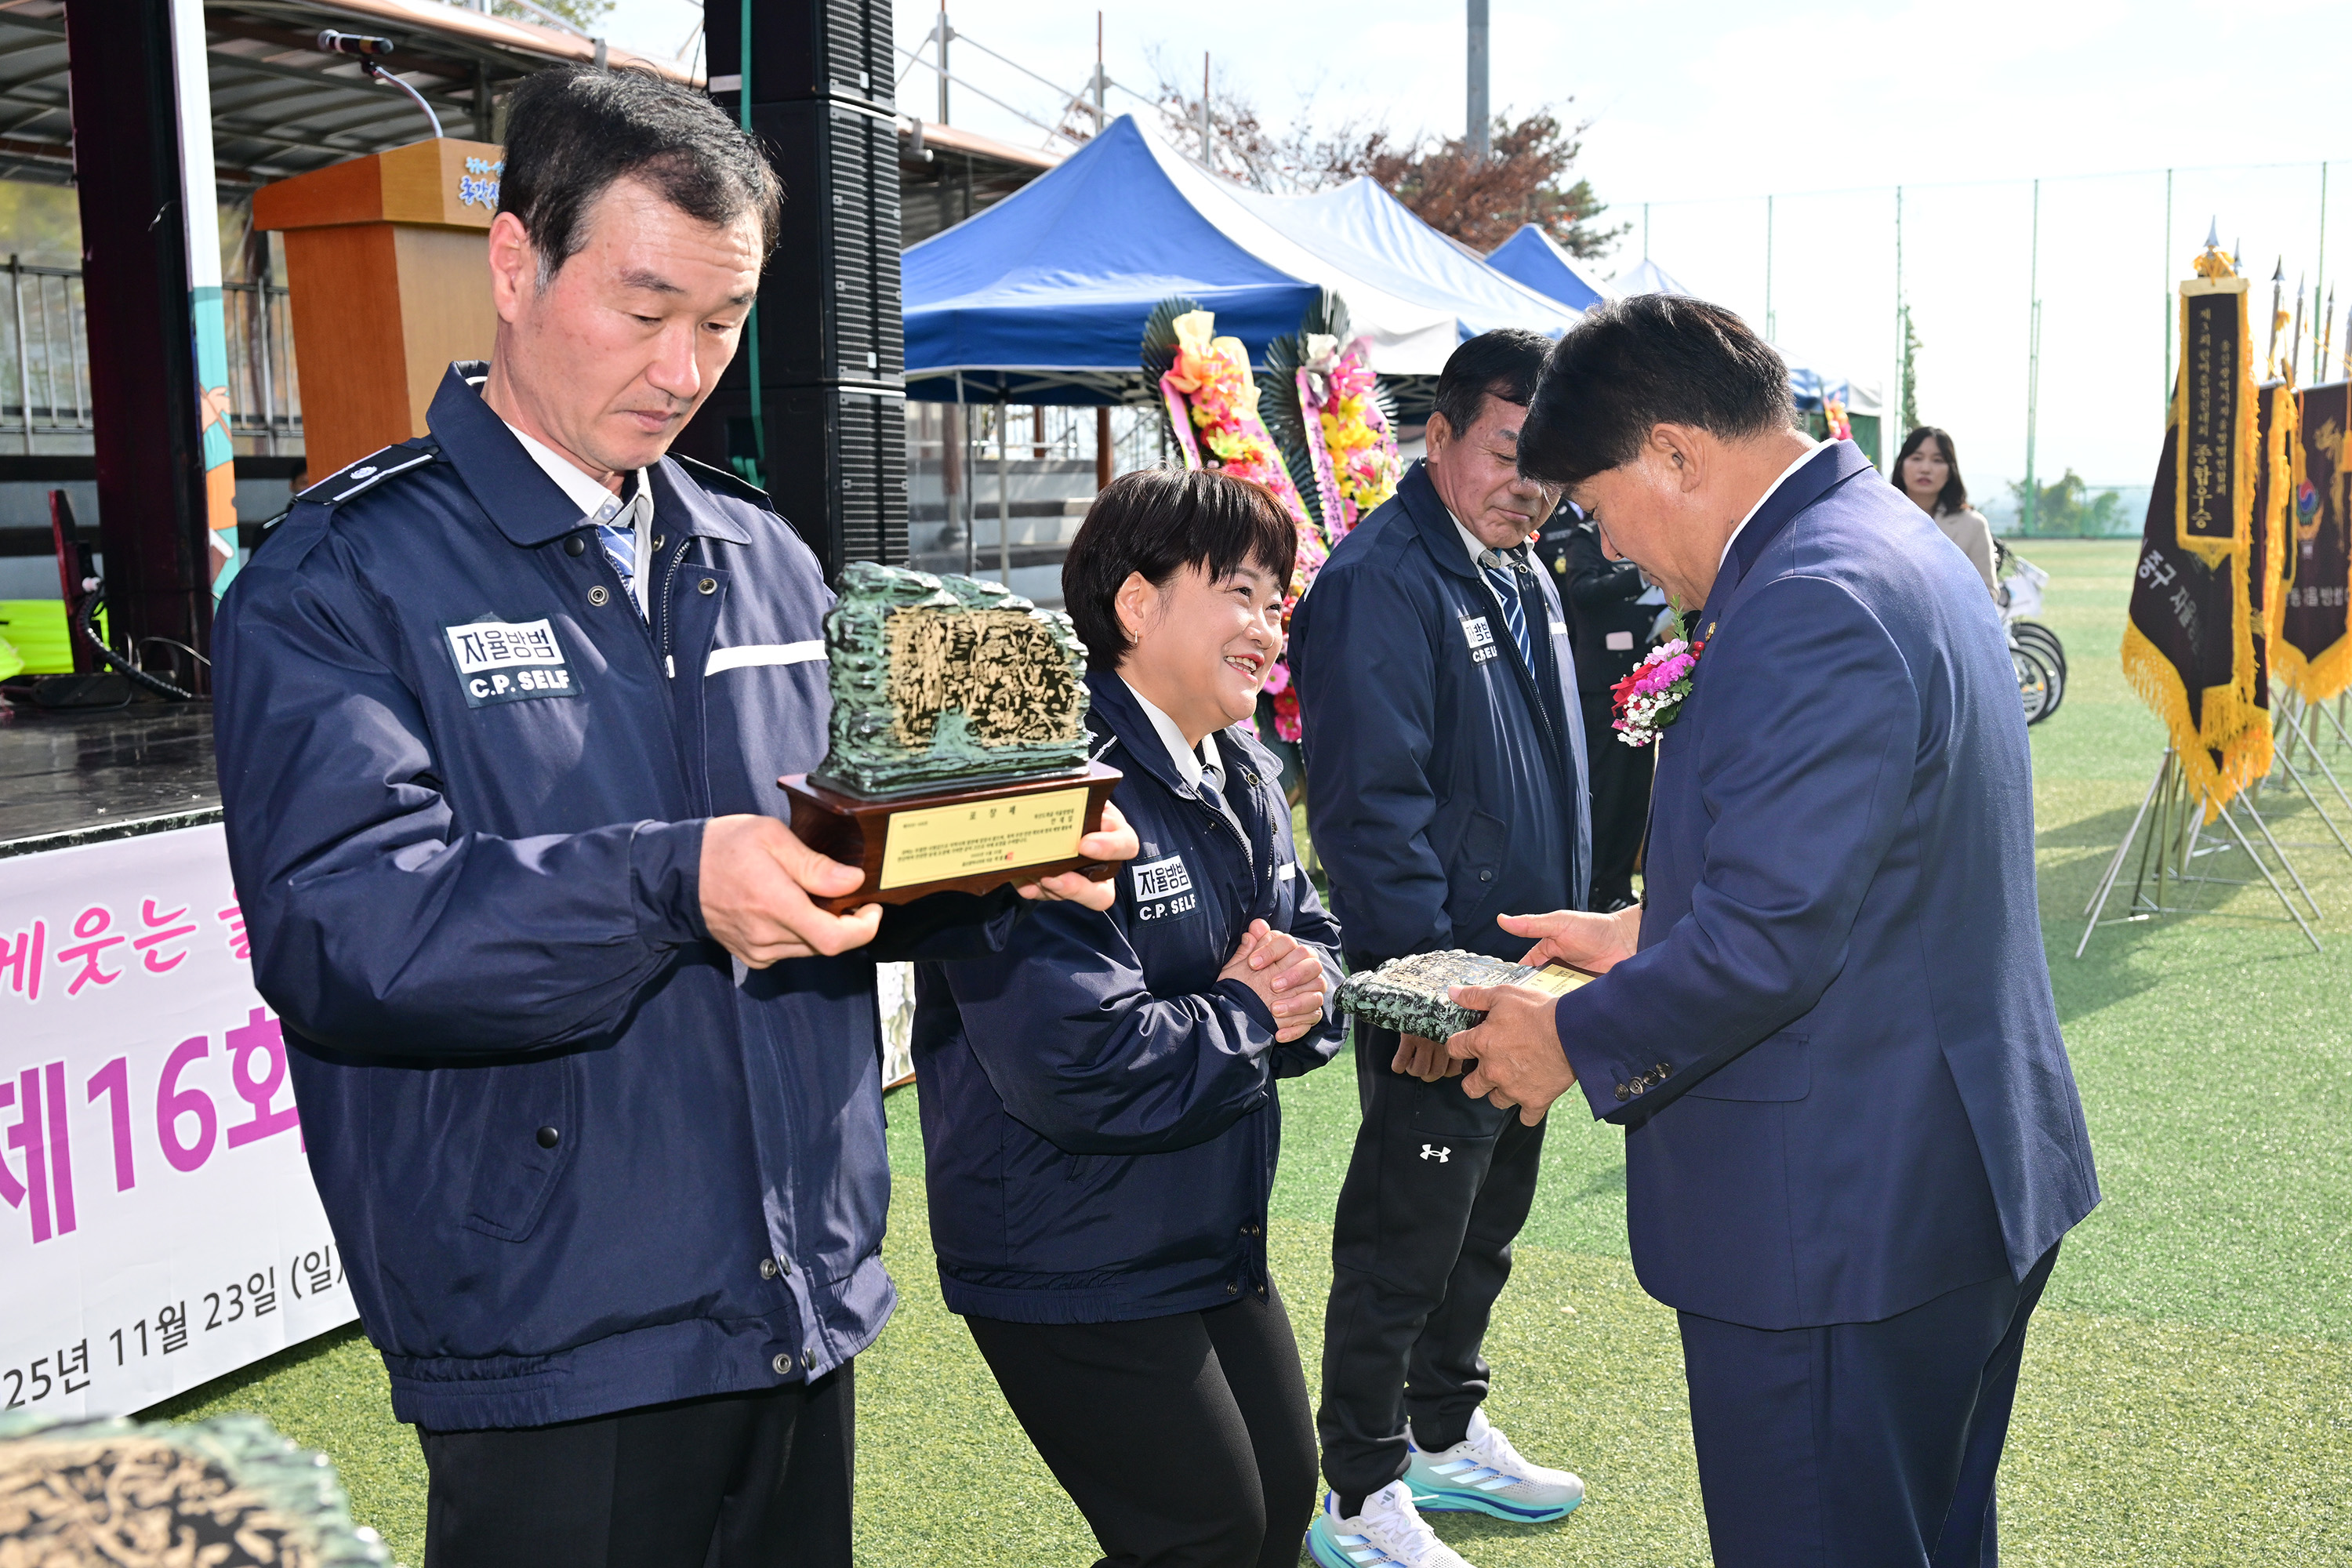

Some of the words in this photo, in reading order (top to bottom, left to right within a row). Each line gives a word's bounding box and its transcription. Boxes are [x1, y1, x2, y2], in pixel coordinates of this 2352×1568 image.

[2191, 444, 2213, 529] 종합우승
[2138, 549, 2177, 590] 중구
[456, 629, 555, 664] 자율방범
[470, 674, 516, 698] C.P.
[517, 670, 570, 691] SELF
[1138, 862, 1189, 895] 자율방범
[1139, 903, 1168, 921] C.P.
[1171, 893, 1196, 915] SELF
[109, 1301, 188, 1367] 11월
[204, 1266, 277, 1331] 23일
